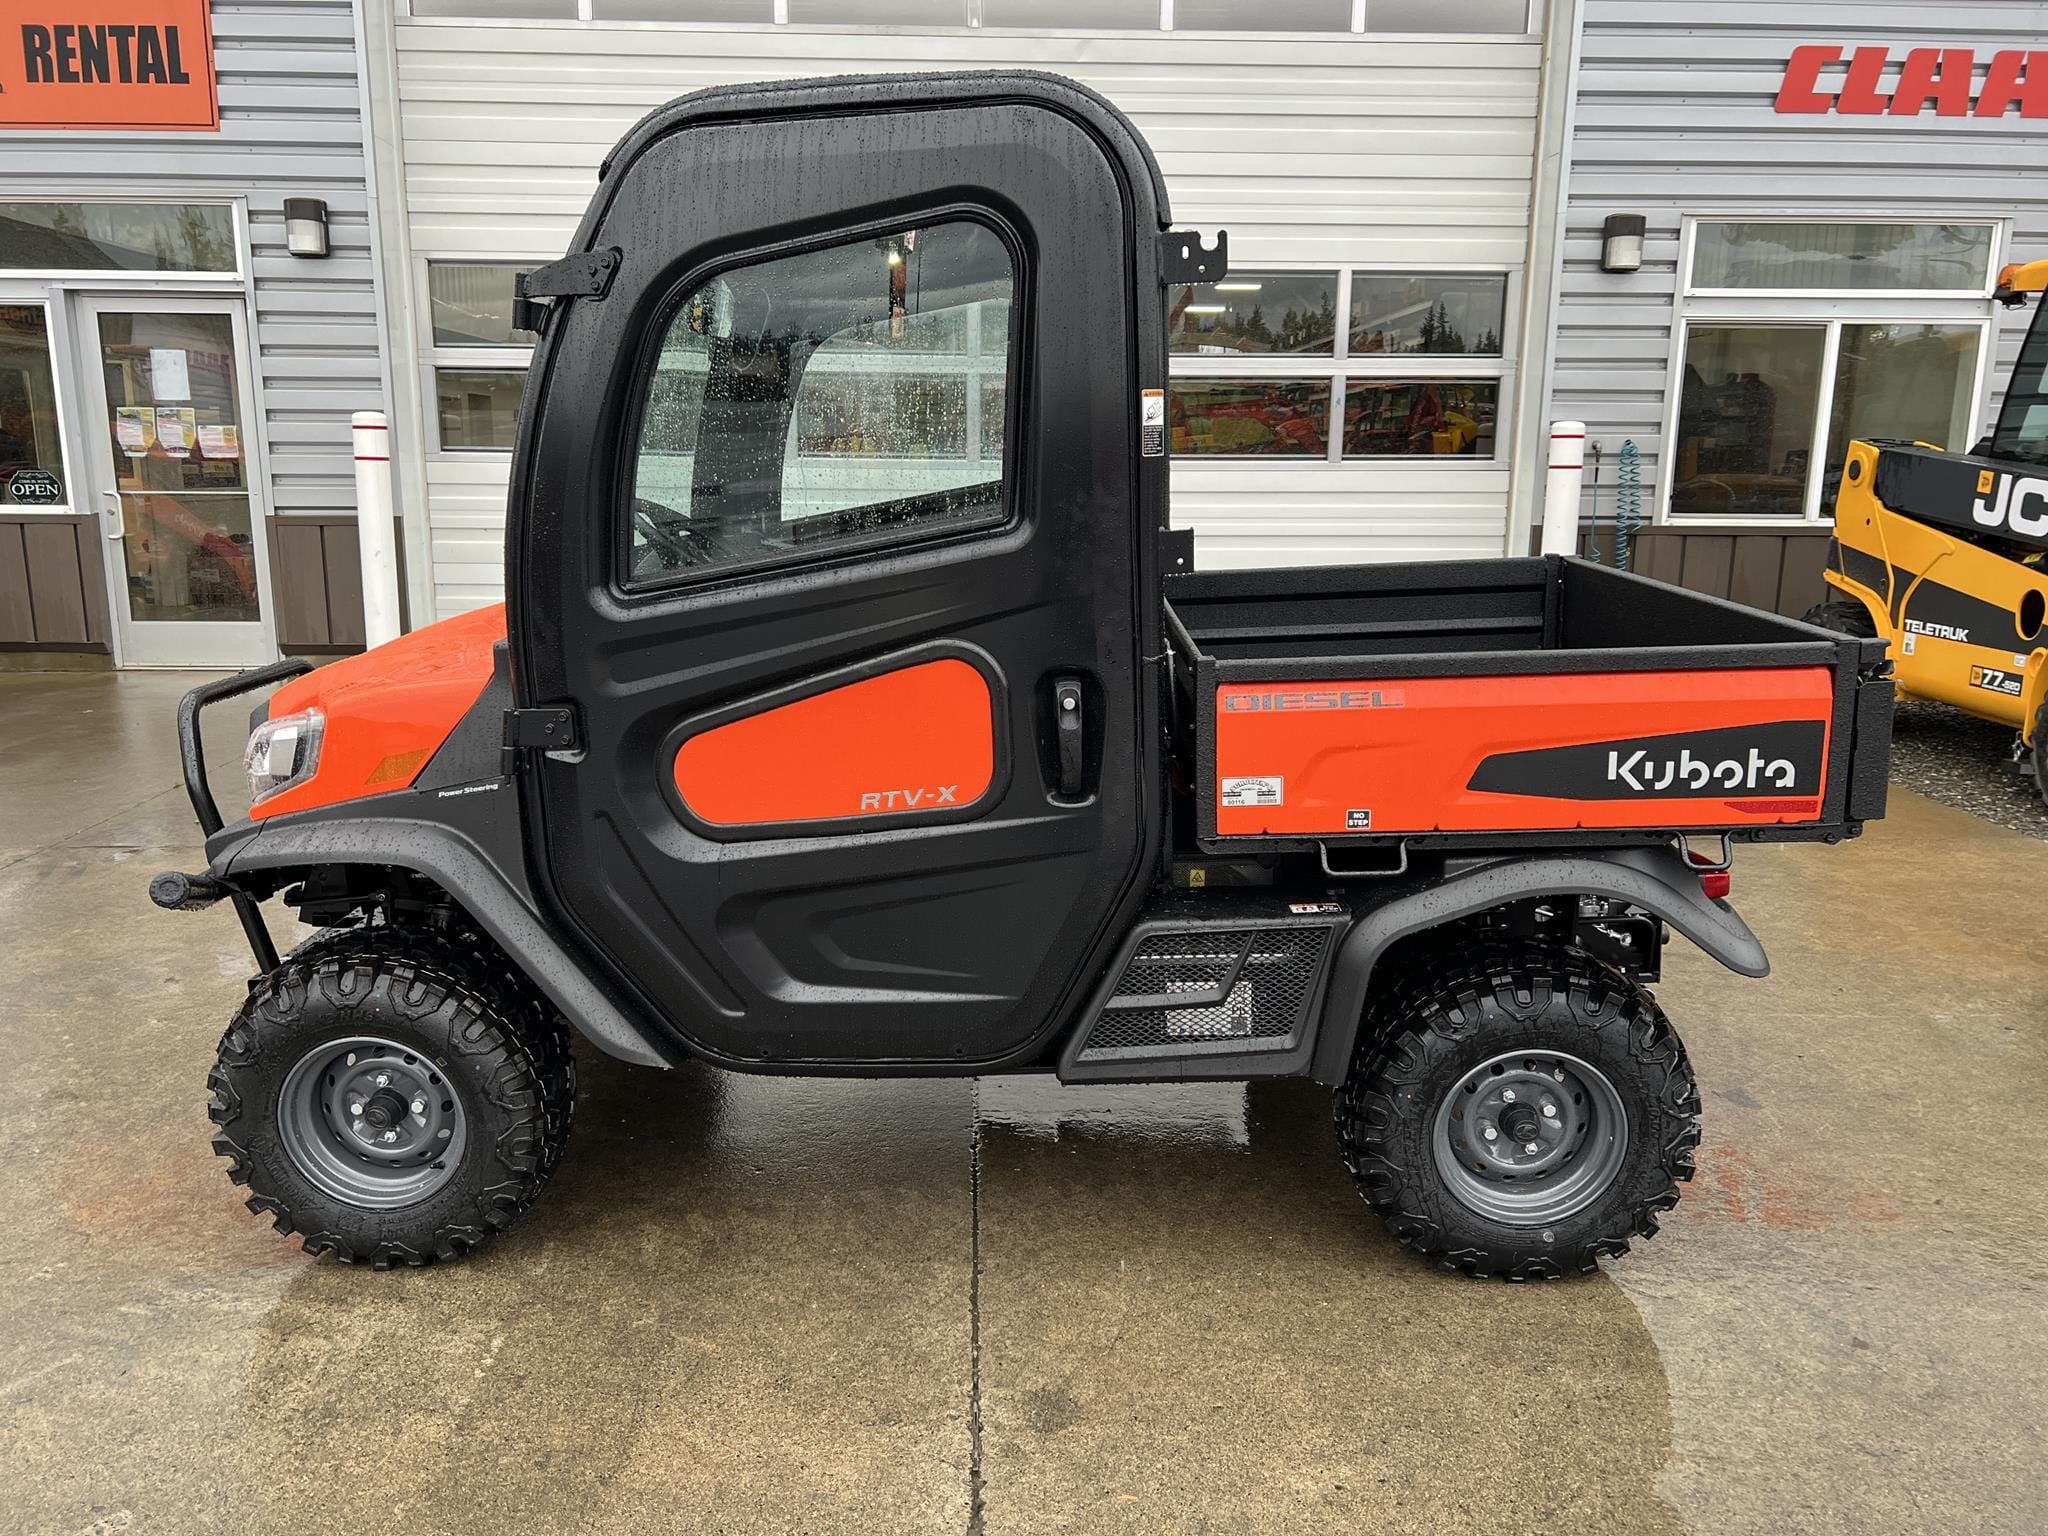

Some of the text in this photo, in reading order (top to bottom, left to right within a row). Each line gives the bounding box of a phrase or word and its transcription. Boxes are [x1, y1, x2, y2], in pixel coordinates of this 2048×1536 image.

[21, 24, 190, 84] RENTAL
[1774, 45, 2048, 118] CLAA
[11, 483, 58, 496] OPEN
[1904, 618, 1969, 642] TELETRUK
[1225, 691, 1404, 712] DIESEL
[1607, 748, 1796, 791] Kubota
[438, 783, 499, 798] Power Steering
[860, 785, 958, 810] RTV-X
